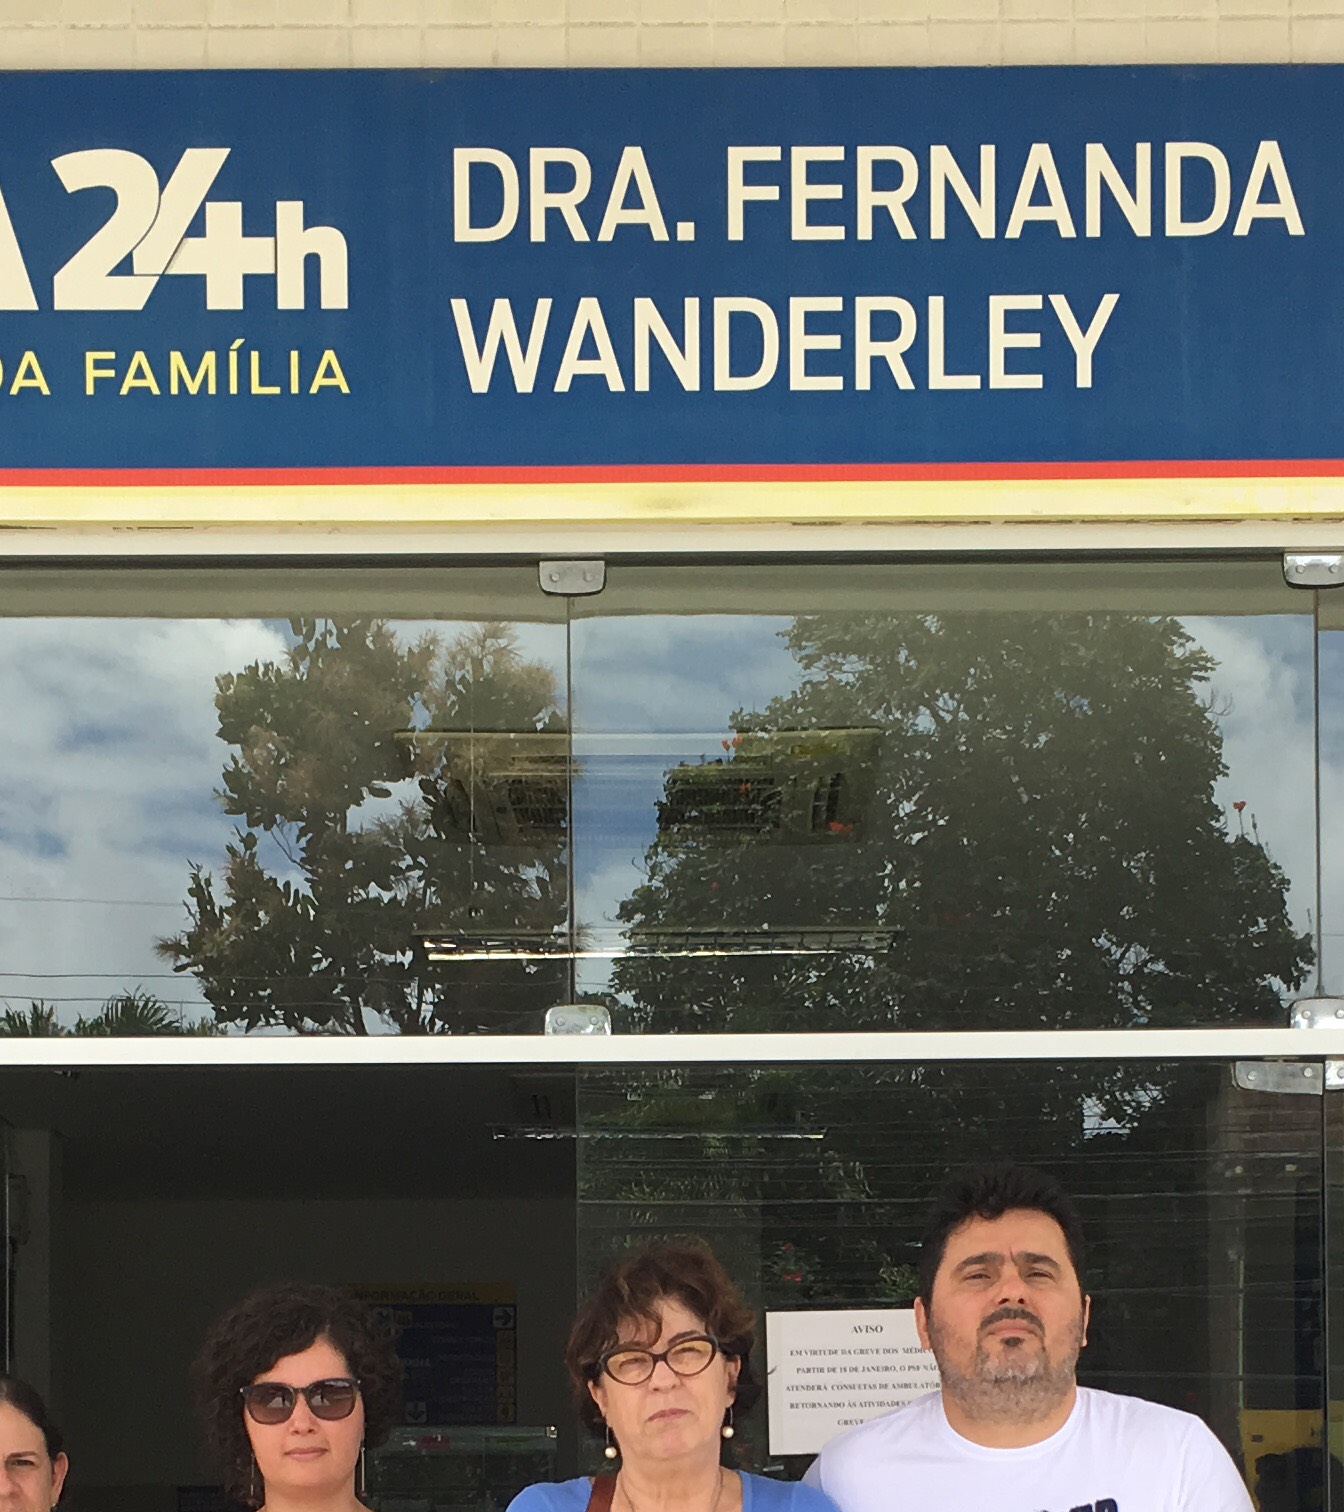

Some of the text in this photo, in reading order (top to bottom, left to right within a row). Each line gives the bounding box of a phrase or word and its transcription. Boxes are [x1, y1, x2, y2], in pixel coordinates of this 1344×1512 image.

[455, 142, 1305, 243] DRA. FERNANDA
[86, 339, 352, 396] FAMÍLIA
[452, 295, 1120, 394] WANDERLEY
[851, 1324, 884, 1334] AVISO
